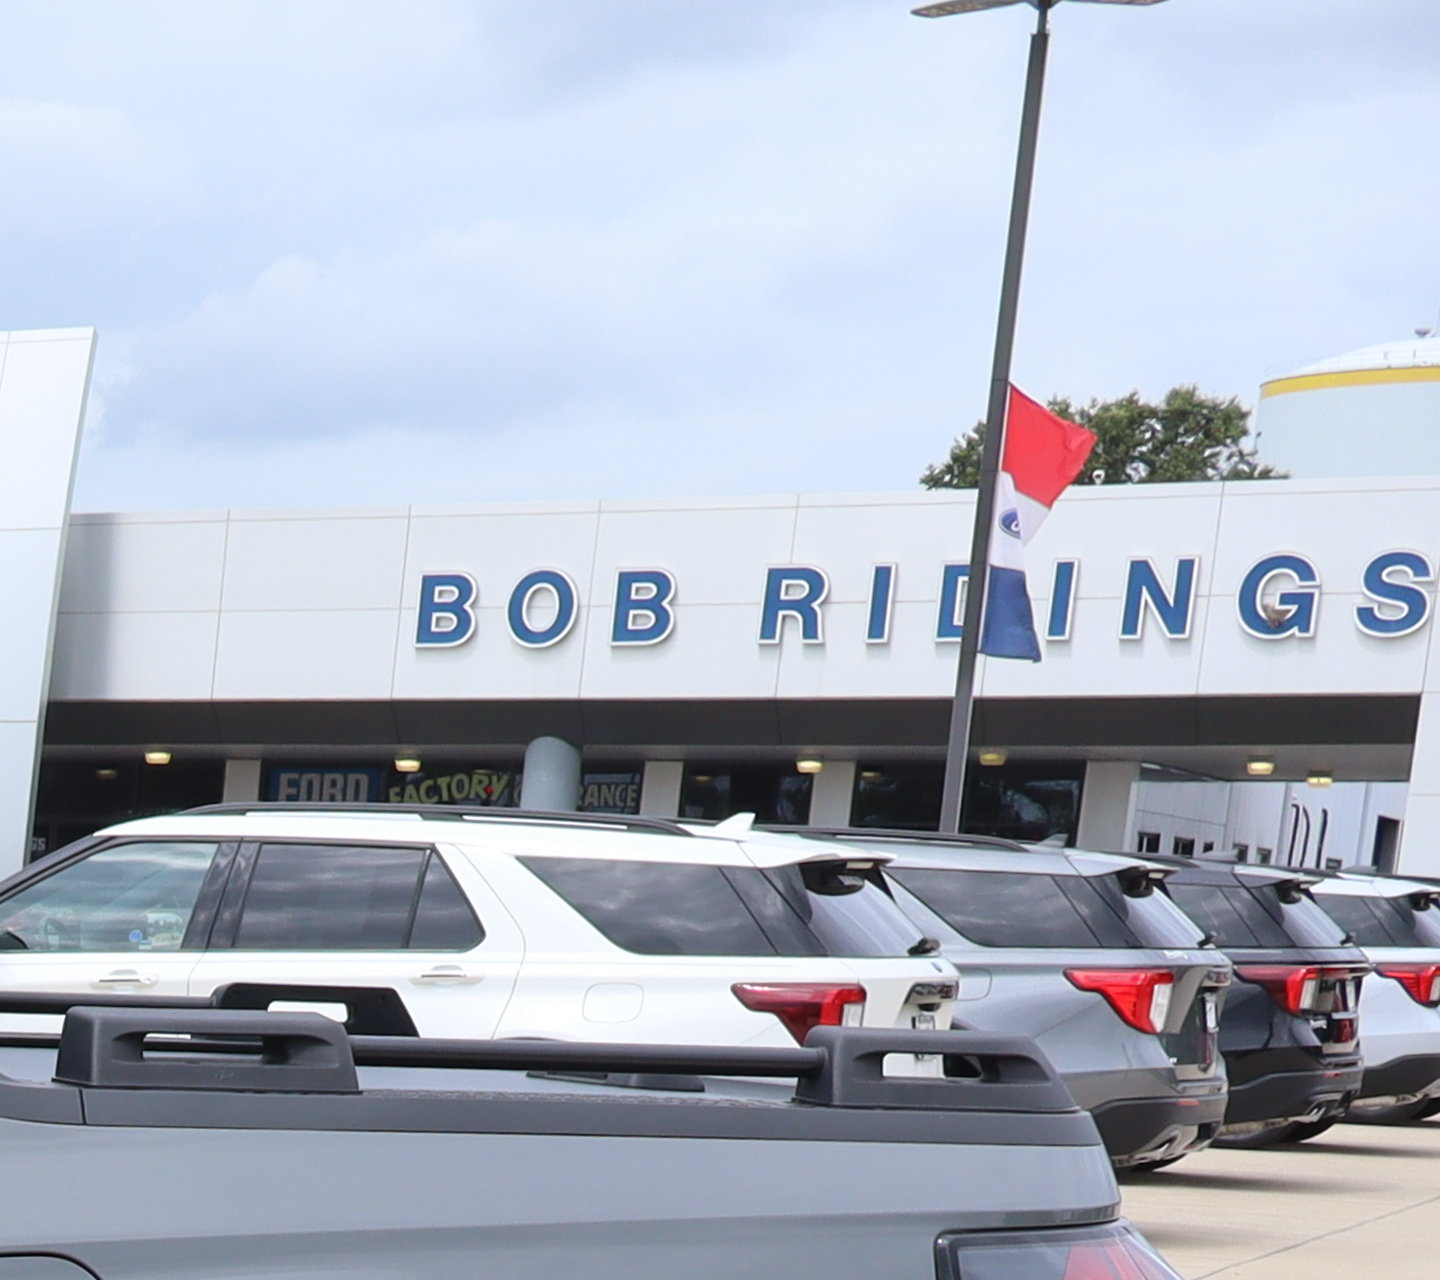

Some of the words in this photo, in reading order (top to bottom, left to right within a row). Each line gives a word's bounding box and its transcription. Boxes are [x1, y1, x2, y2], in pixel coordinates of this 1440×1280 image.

[415, 567, 678, 648] BOB
[278, 772, 370, 803] FORD
[388, 770, 511, 803] FACTORY
